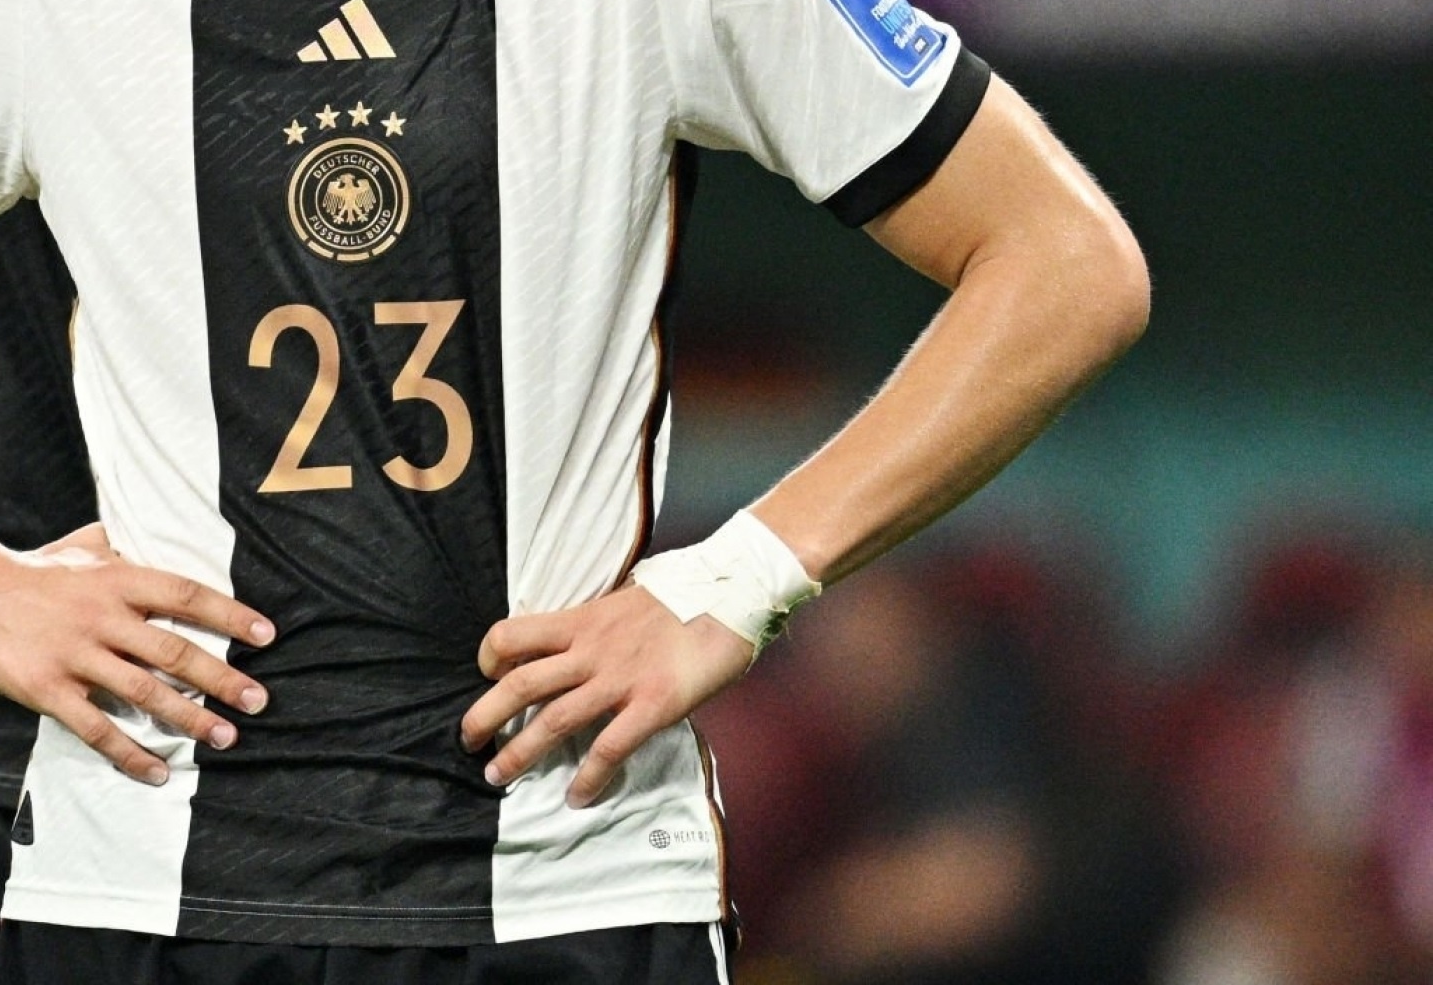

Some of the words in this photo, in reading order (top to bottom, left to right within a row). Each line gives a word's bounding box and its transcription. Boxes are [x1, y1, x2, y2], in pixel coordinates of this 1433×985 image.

[313, 154, 380, 179] DEUTSCHER
[309, 209, 391, 246] FUSSBALL-BUND
[248, 299, 473, 494] 23
